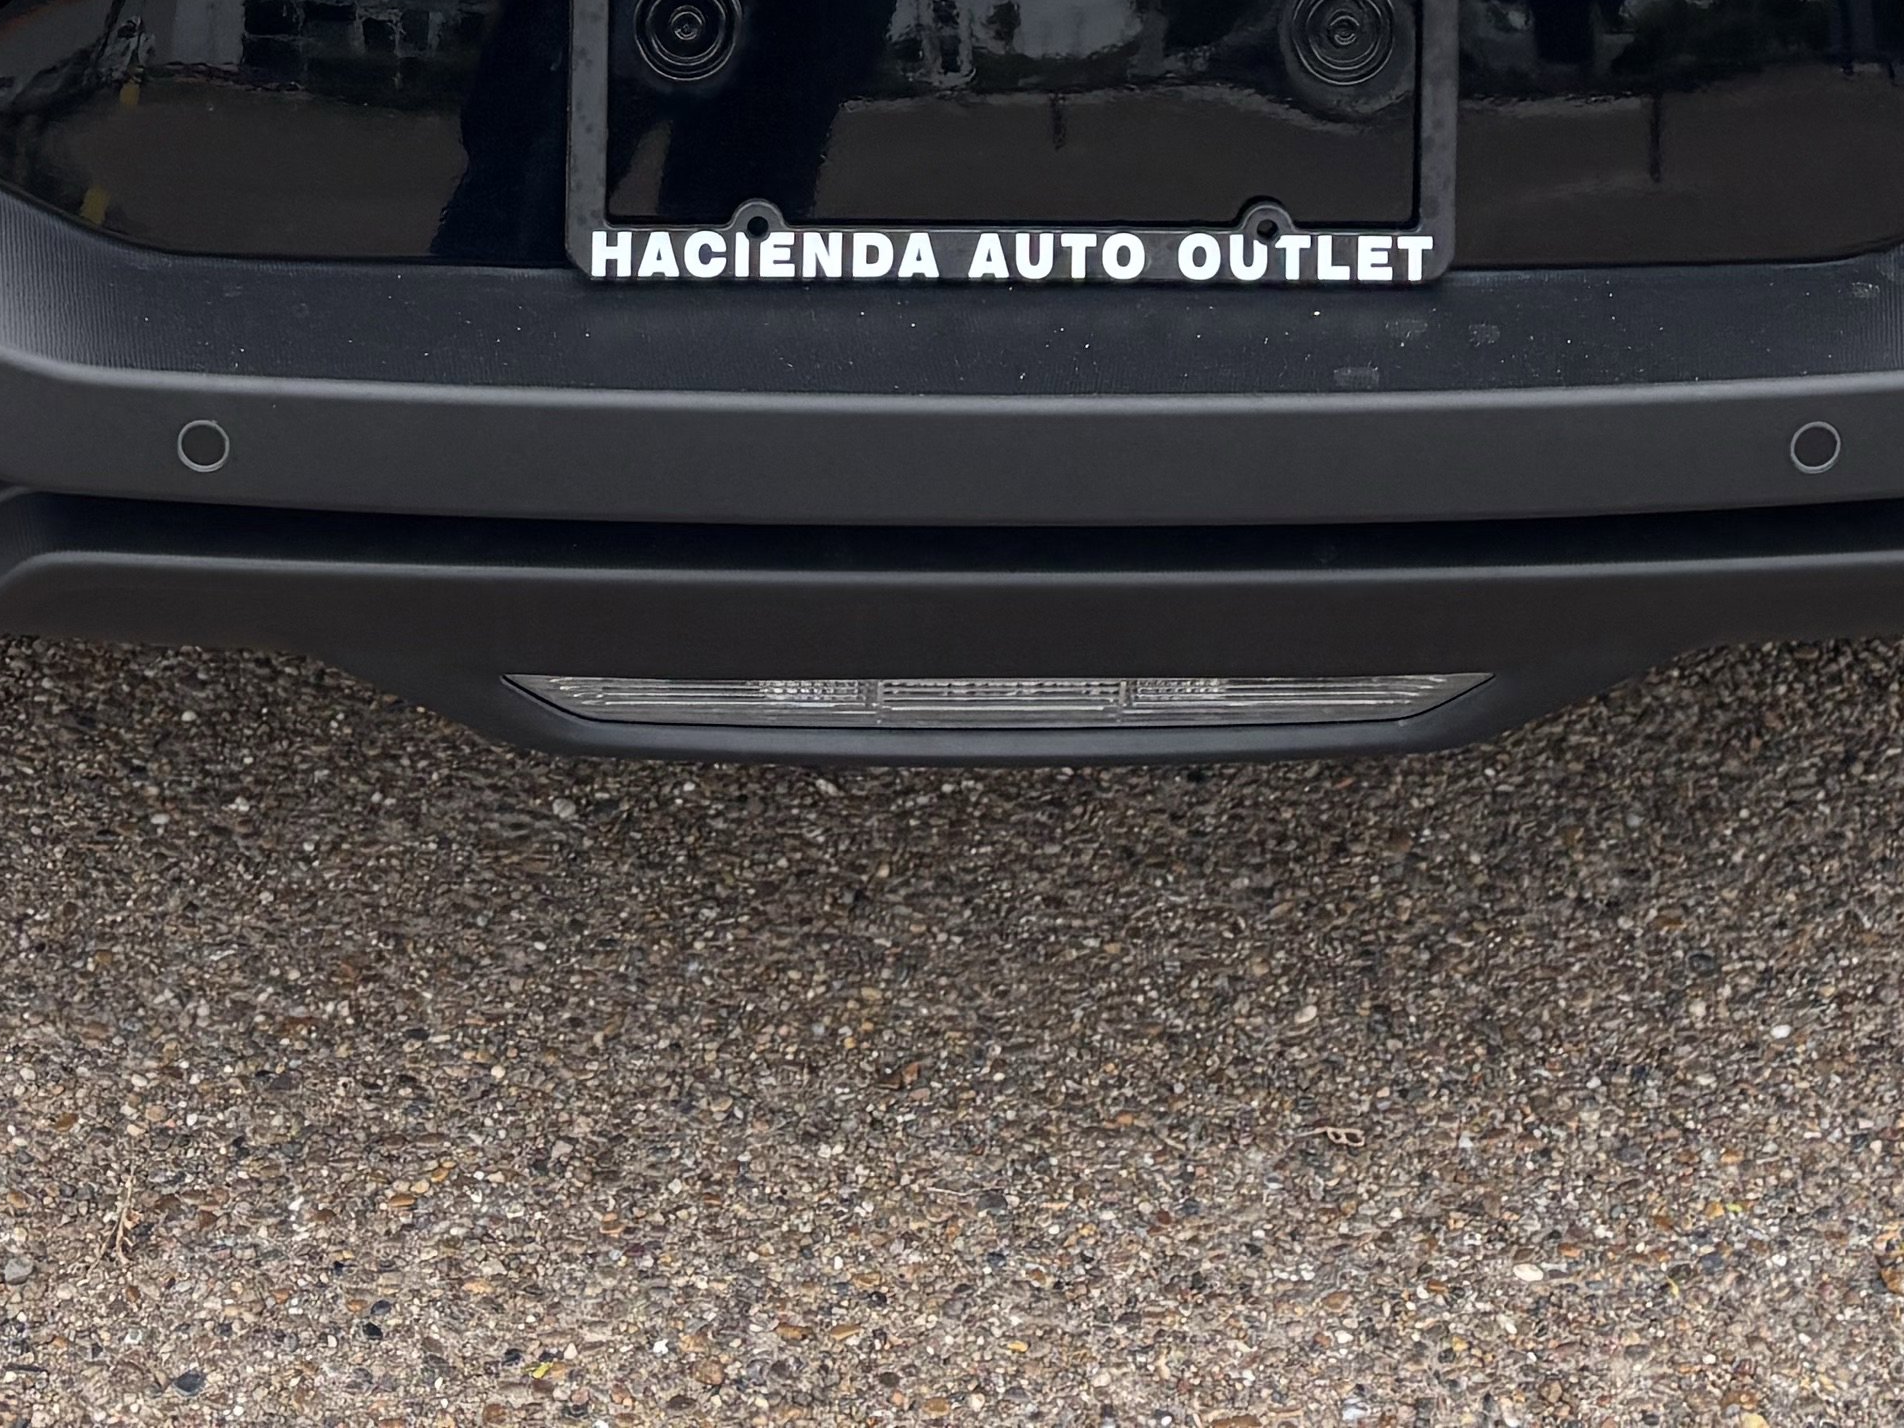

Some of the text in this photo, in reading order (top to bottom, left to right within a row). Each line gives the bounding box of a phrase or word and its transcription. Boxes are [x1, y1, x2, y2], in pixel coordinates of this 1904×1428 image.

[590, 230, 1435, 282] HACIENDA AUTO OUTLET
